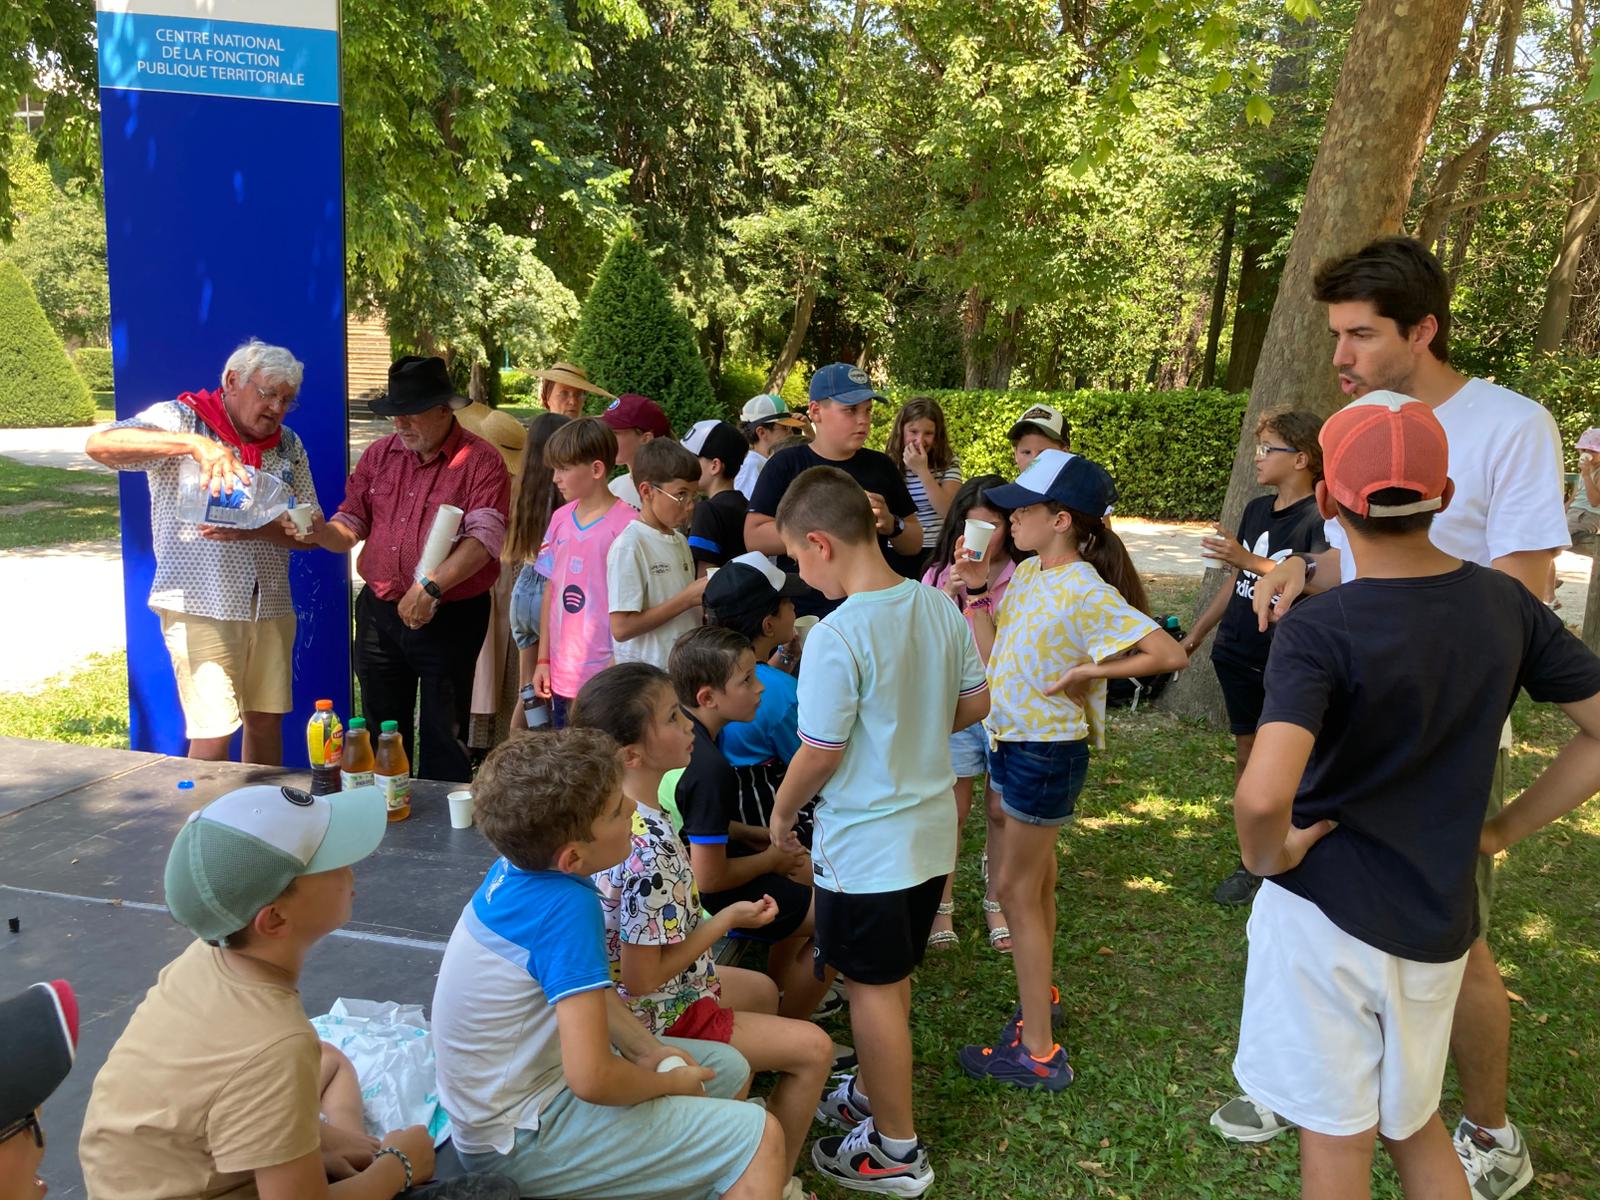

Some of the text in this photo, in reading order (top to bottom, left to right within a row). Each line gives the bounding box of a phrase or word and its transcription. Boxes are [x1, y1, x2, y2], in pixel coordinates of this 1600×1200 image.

[156, 28, 285, 51] CENTRE NATIONAL
[162, 46, 280, 67] DE LA FONCTION
[137, 60, 305, 86] PUBLIQUE TERRITORIALE
